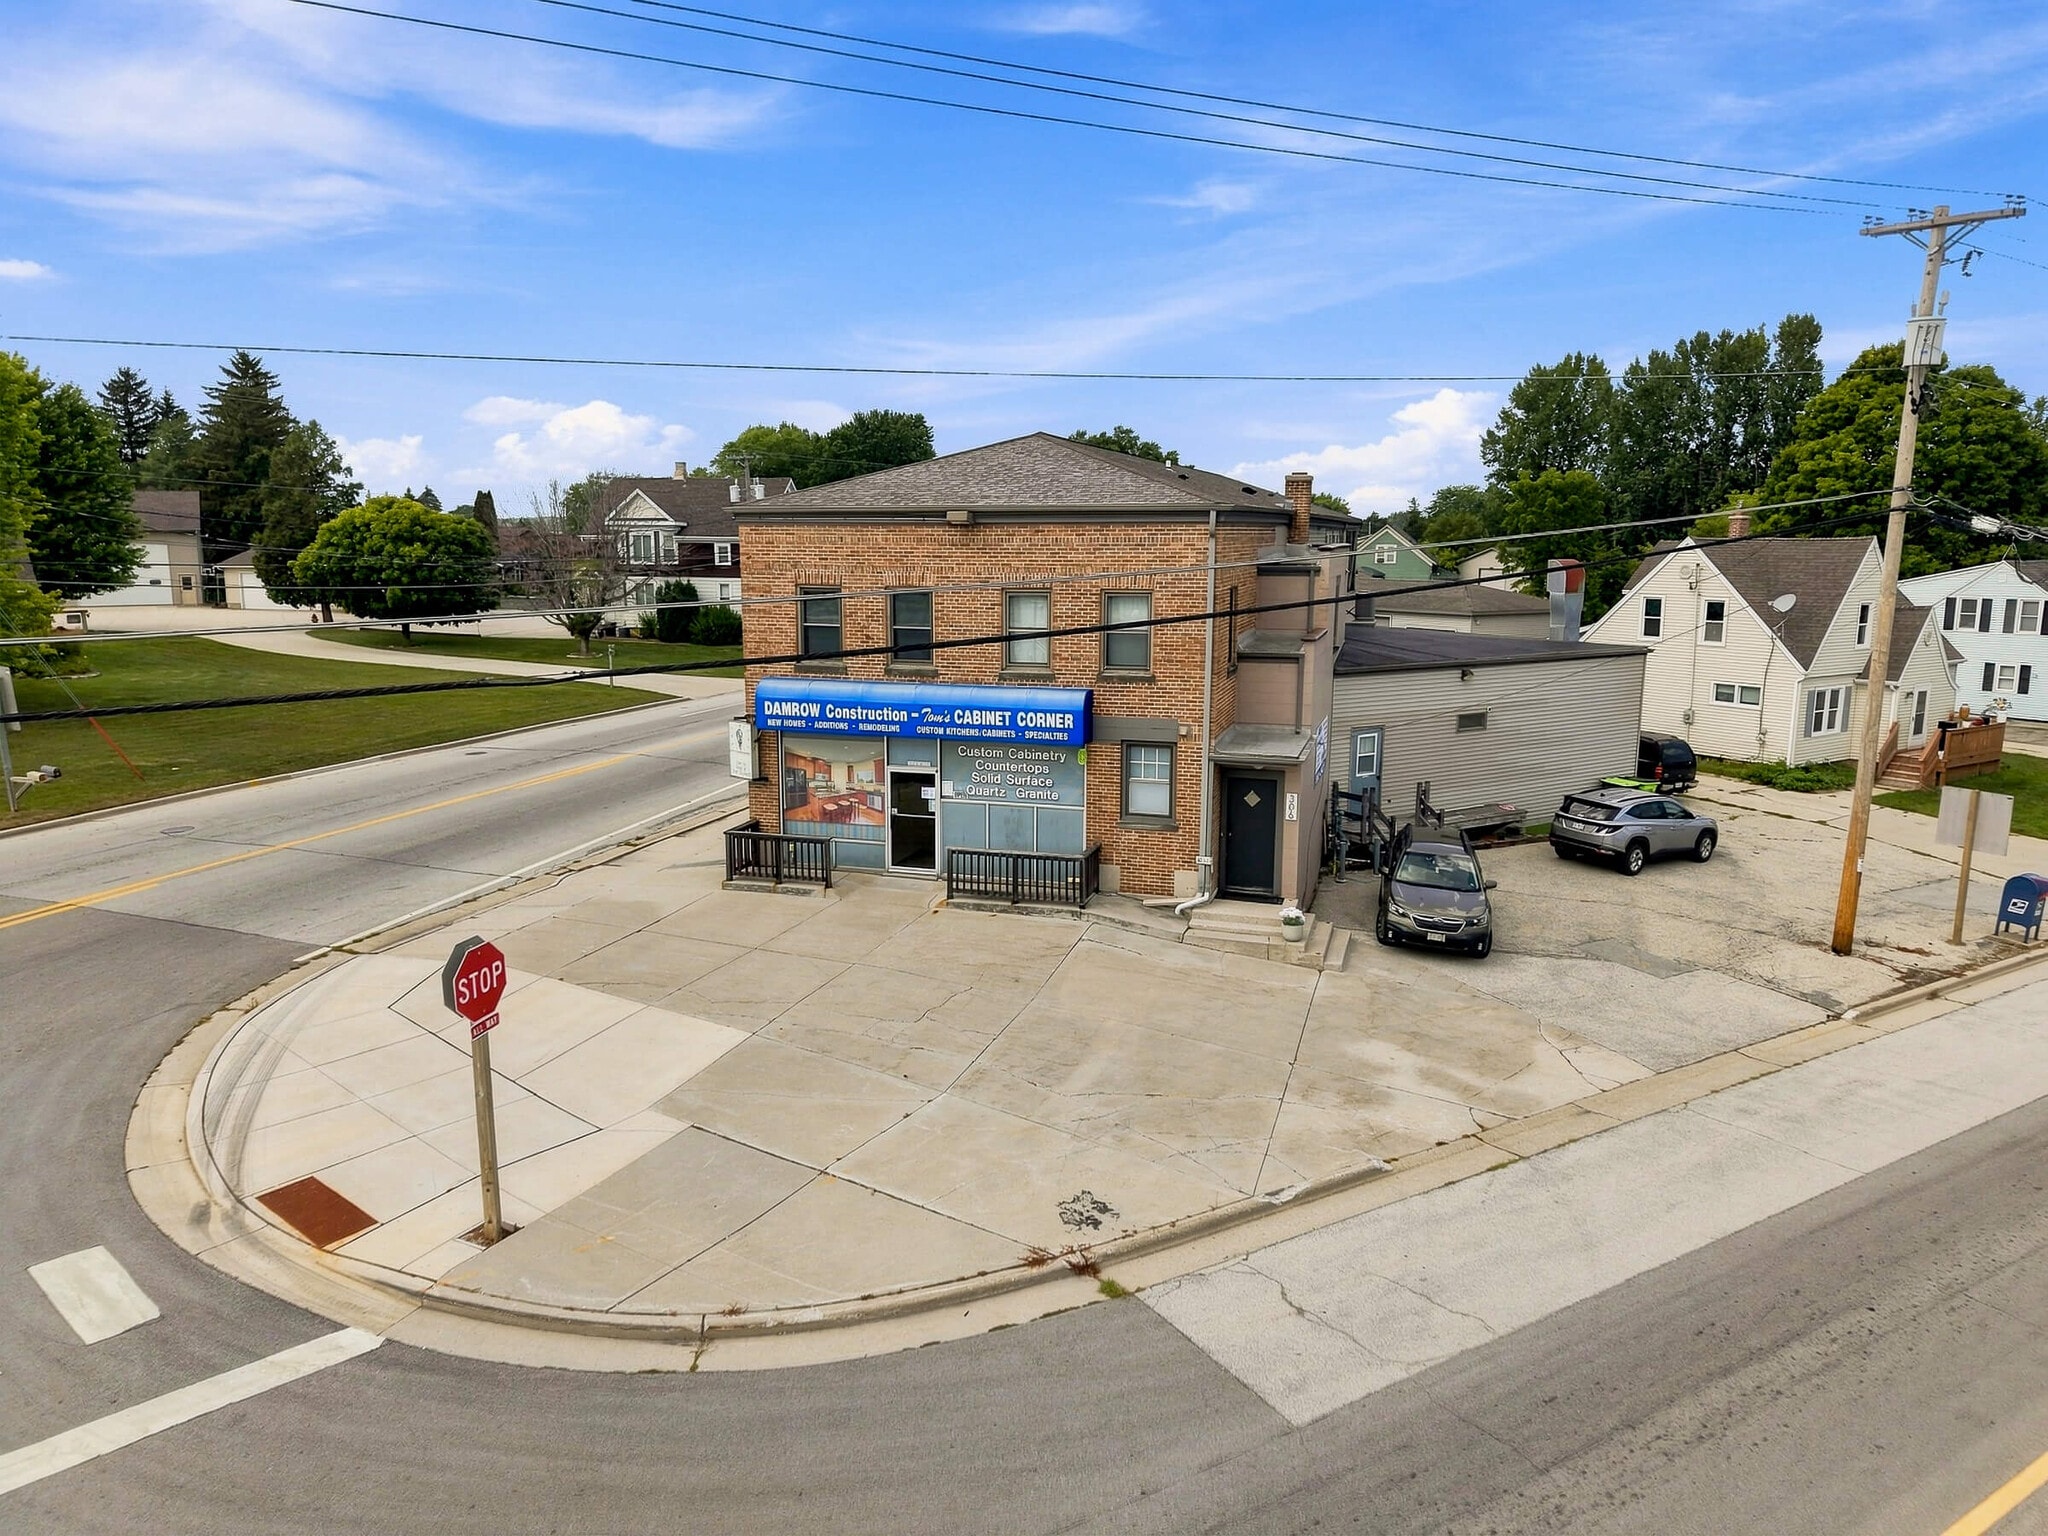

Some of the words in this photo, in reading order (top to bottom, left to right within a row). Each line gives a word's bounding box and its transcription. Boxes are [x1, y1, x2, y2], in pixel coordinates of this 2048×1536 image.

[764, 701, 820, 718] DAMROW
[826, 704, 908, 722] Construction
[921, 707, 951, 723] Tom's
[954, 709, 1012, 727] CABINET
[1017, 712, 1074, 729] CORNER
[767, 718, 782, 727] NEW
[783, 719, 806, 728] HOMES
[814, 721, 848, 730] ADDITIONS
[859, 722, 900, 733] REMODELING
[916, 726, 944, 735] CUSTOM
[1024, 731, 1068, 741] SPECIALTIES
[958, 745, 1003, 759] Custom
[1008, 748, 1067, 763] Cabinetry
[975, 760, 1050, 775] Countertops
[971, 772, 1001, 784] Solid
[1006, 774, 1053, 787] Surface
[966, 785, 1006, 798] Quartz
[1015, 788, 1059, 800] Granite
[458, 960, 503, 1004] STOP
